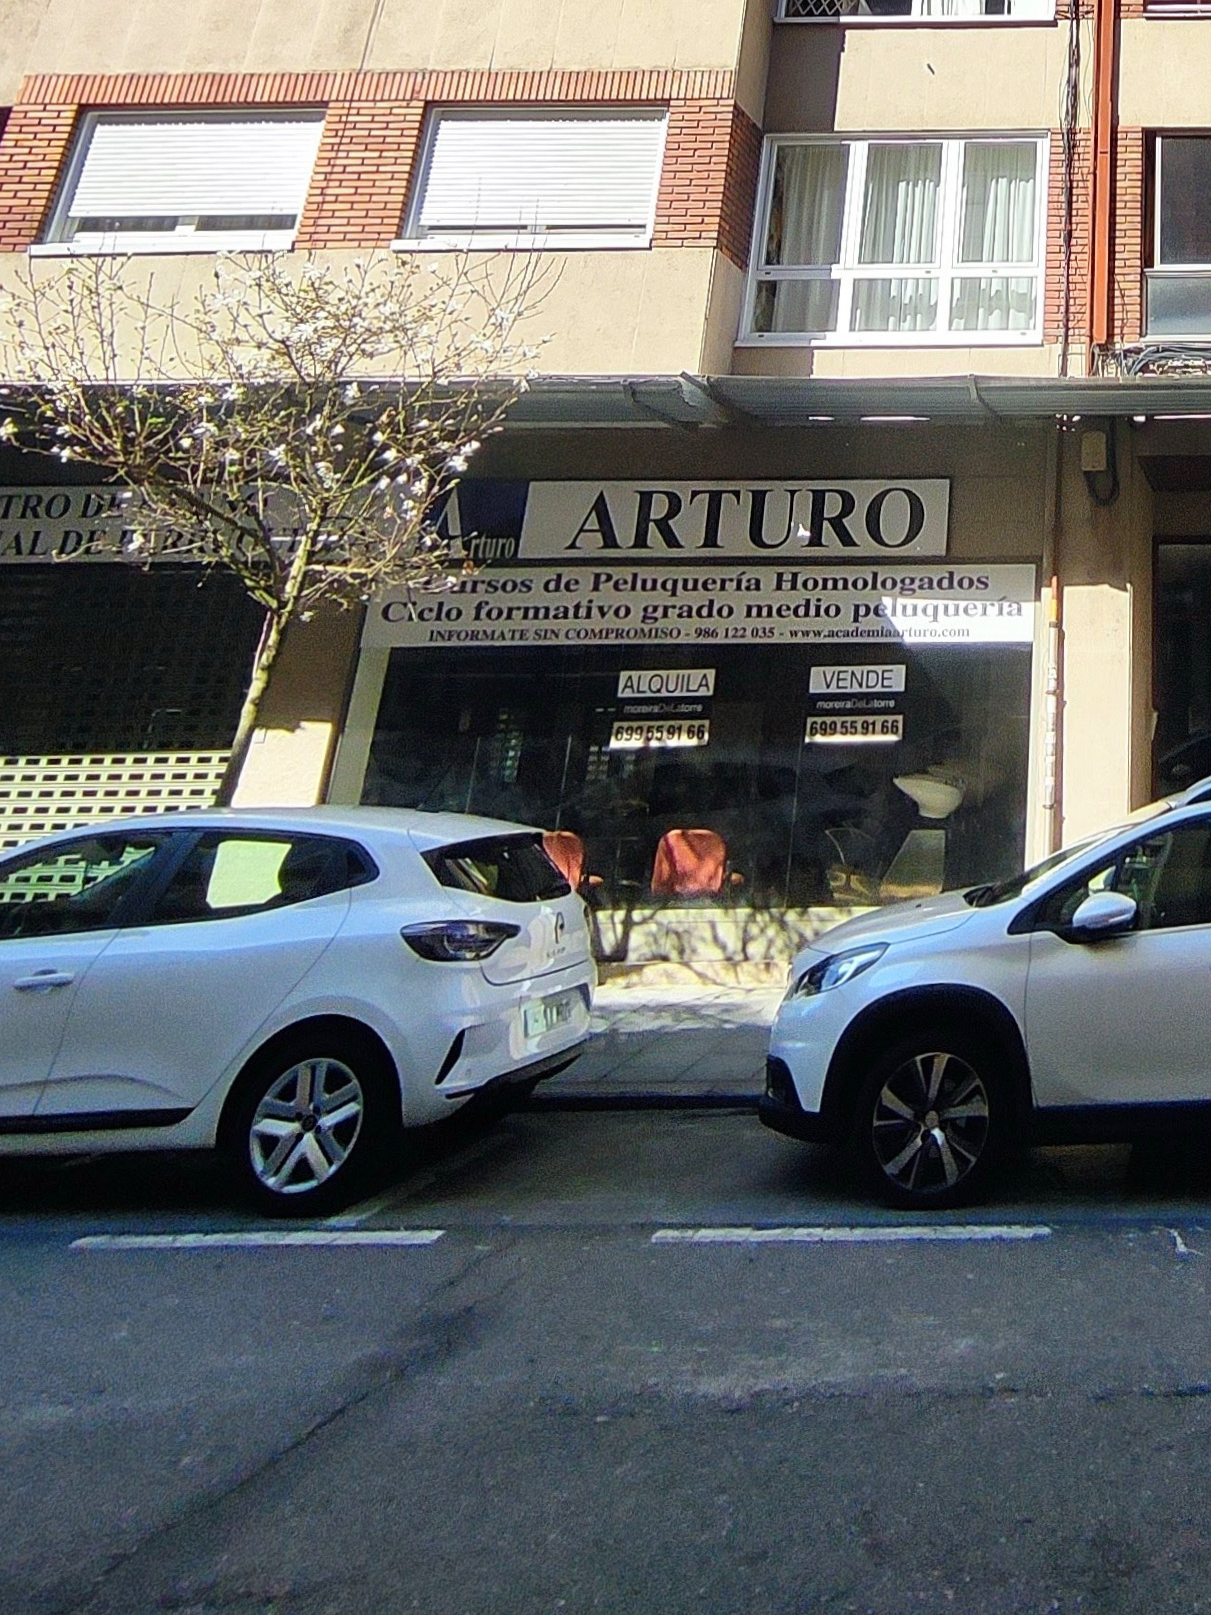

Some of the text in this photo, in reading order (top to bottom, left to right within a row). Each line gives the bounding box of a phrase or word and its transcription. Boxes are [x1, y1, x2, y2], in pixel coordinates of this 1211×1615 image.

[564, 487, 925, 551] ARTURO
[57, 530, 109, 556] DE
[543, 572, 580, 593] de
[591, 571, 761, 598] Peluquería
[773, 570, 990, 596] Homologados
[381, 596, 1023, 624] Ciclo formativo grado medio peluquería
[428, 627, 529, 643] INFORMATE
[532, 627, 560, 642] SIN
[564, 626, 682, 642] COMPROMISO
[693, 626, 720, 640] 986
[723, 626, 747, 640] 122
[750, 626, 776, 639] 035
[620, 673, 711, 695] ALQUILA
[822, 669, 894, 690] VENDE
